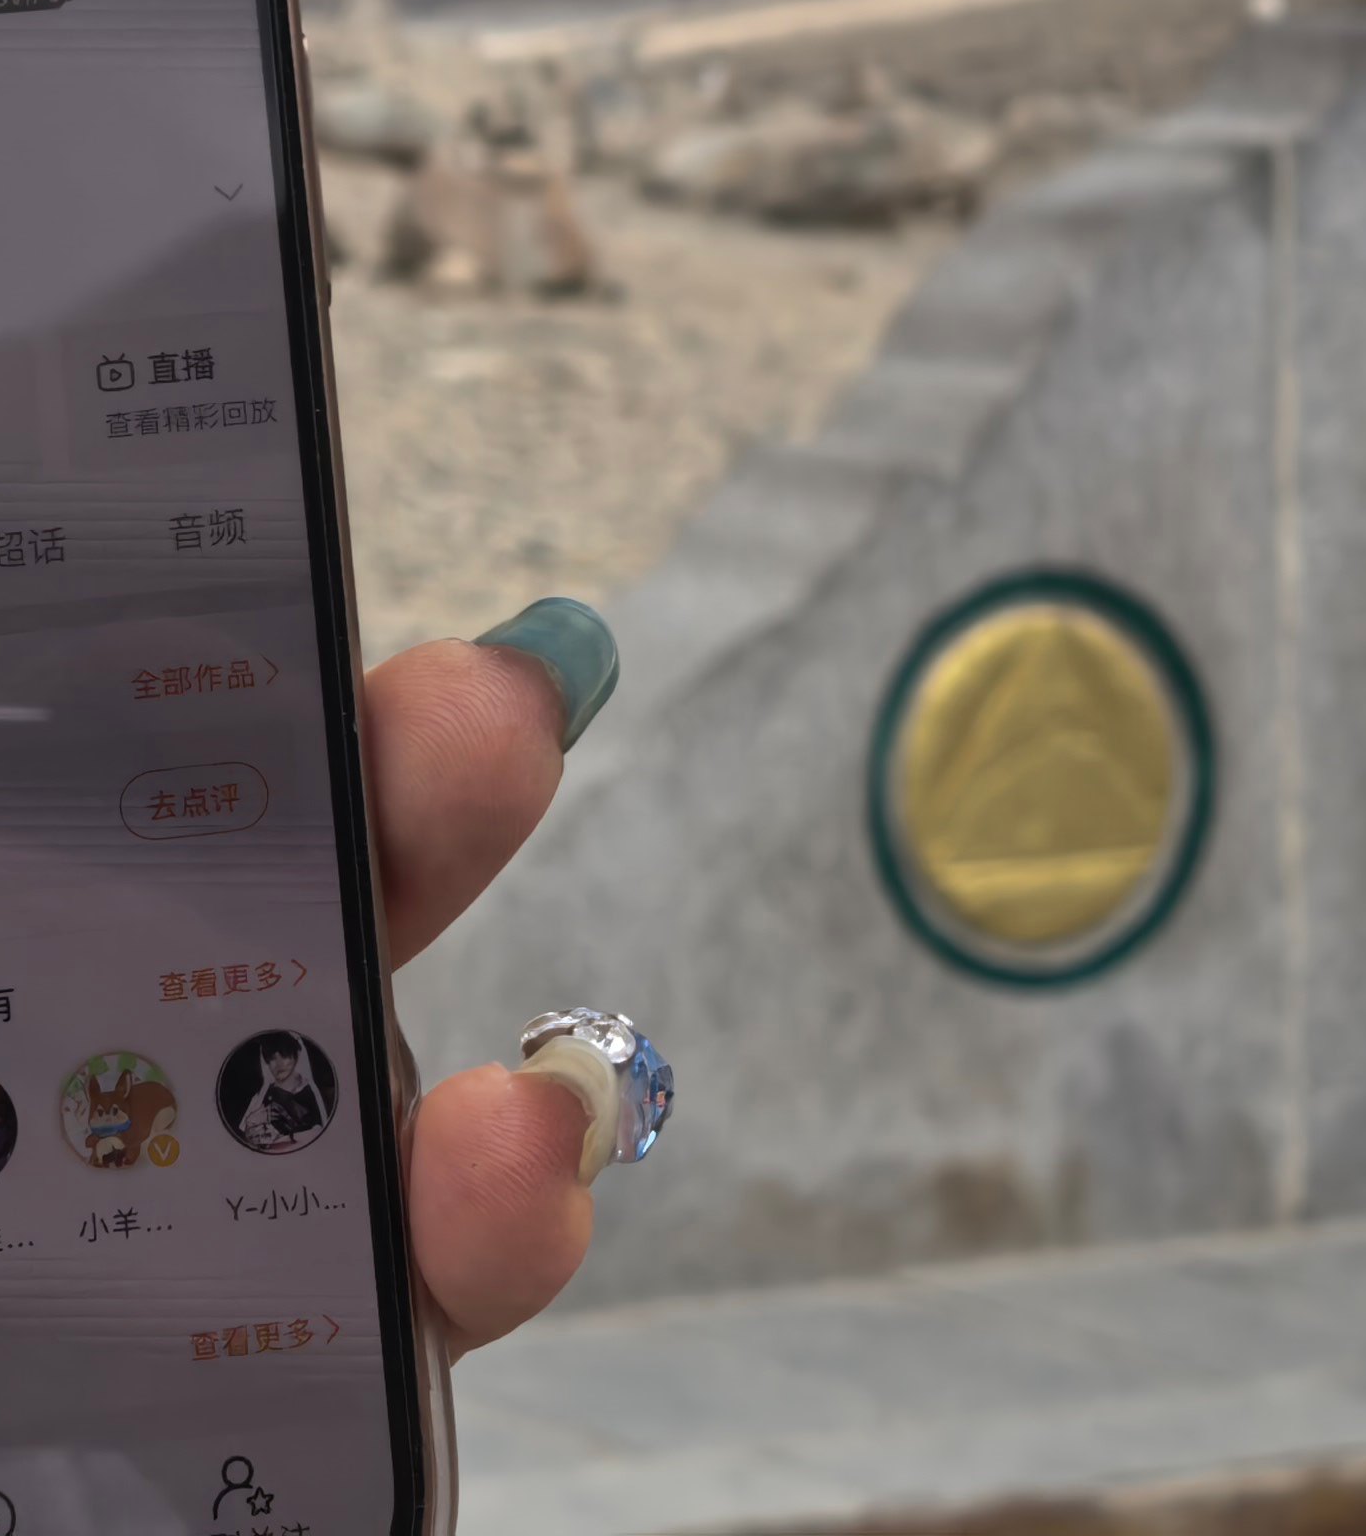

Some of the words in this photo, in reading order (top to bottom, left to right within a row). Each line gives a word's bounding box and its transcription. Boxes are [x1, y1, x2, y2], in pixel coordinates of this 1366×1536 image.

[146, 347, 215, 385] 直播
[104, 395, 278, 439] 查看精彩回放
[168, 508, 247, 551] 音频
[131, 658, 256, 702] 全部作品
[146, 784, 241, 822] 去点评
[158, 961, 284, 1003] 查看更多
[191, 1319, 315, 1361] 查看更多
